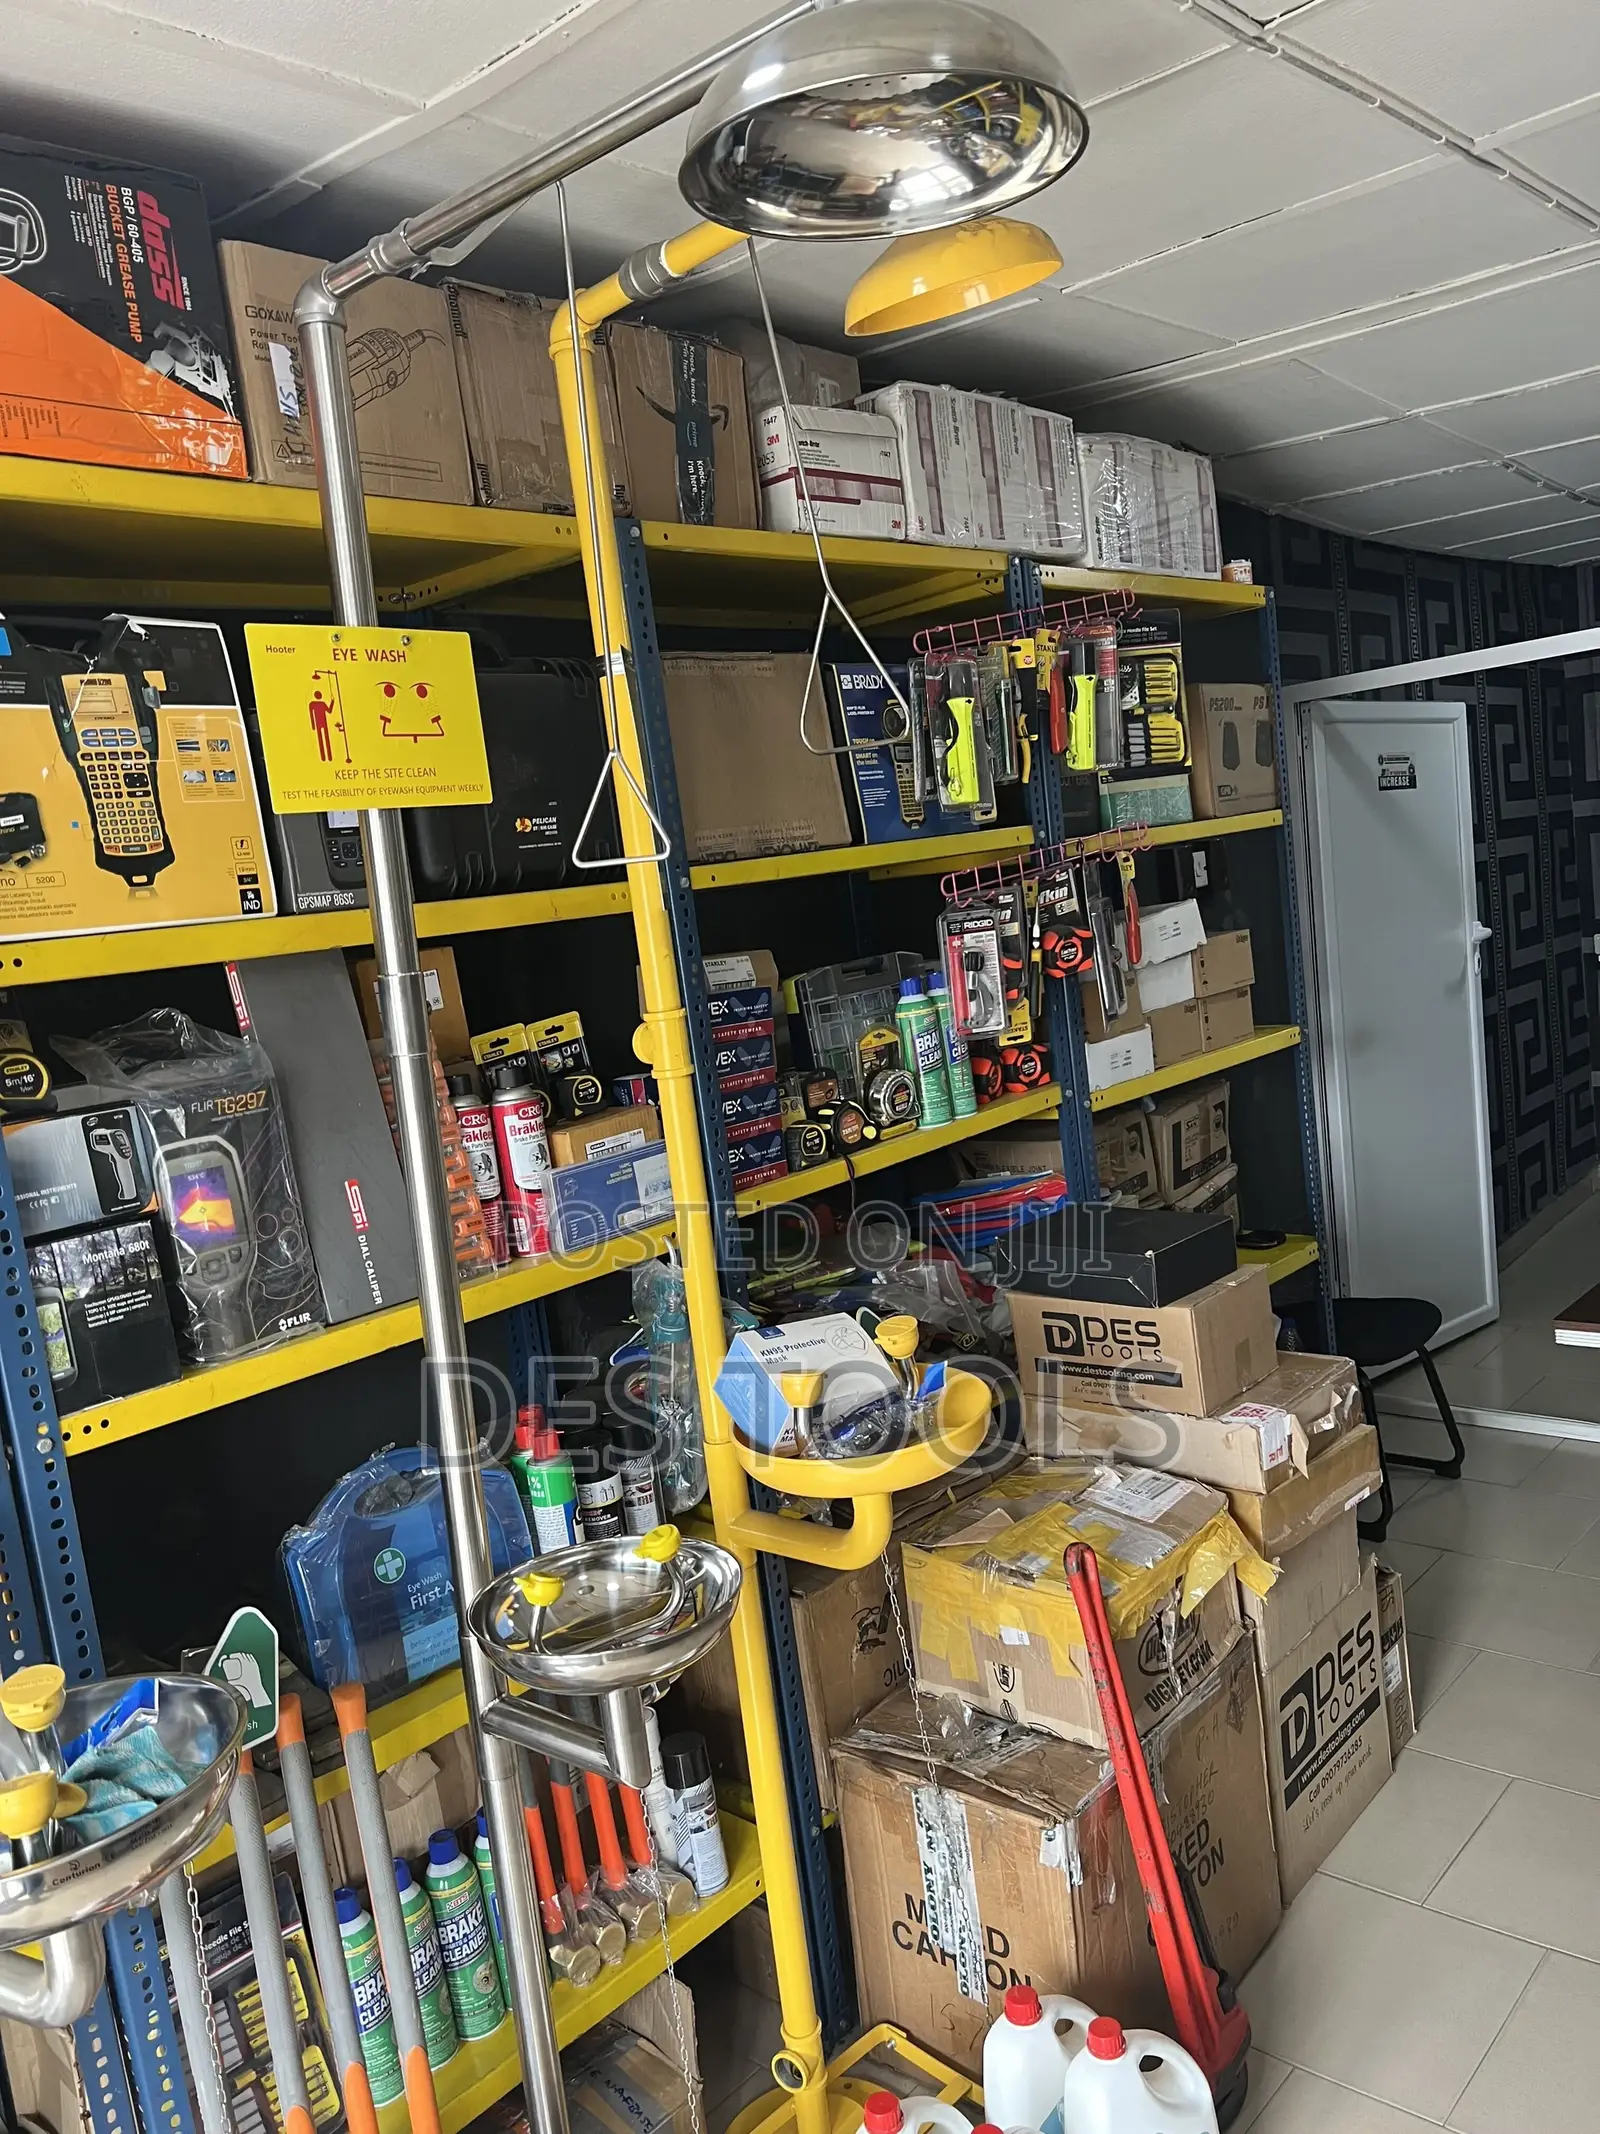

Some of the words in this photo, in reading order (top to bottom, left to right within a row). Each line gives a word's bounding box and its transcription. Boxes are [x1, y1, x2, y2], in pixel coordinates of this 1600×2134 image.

[120, 186, 136, 215] BGP
[128, 224, 144, 264] 60-405
[105, 184, 126, 241] BUCKET
[116, 242, 136, 300] GREASE
[126, 302, 143, 344] PUMP
[250, 328, 279, 340] Power
[763, 416, 778, 427] 7447
[690, 420, 698, 449] prime
[766, 434, 780, 446] 3M
[688, 478, 697, 496] here.
[892, 520, 902, 530] 3M
[265, 644, 297, 655] Hooter
[332, 648, 358, 662] EYE
[364, 648, 408, 664] WASH
[853, 674, 884, 690] BRADY
[334, 768, 360, 781] KEEP
[362, 768, 382, 780] THE
[384, 768, 404, 780] SITE
[406, 767, 437, 778] CLEAN
[1380, 776, 1411, 788] INCREASE
[282, 790, 301, 800] TEST
[302, 790, 320, 799] THE
[320, 788, 365, 798] FEASIBILITY
[366, 787, 378, 796] OF
[378, 786, 414, 796] EYEWASH
[416, 784, 457, 795] EQUIPMENT
[458, 784, 485, 794] WEEKLY
[532, 816, 557, 824] PELICAN
[36, 876, 56, 885] 5200
[243, 900, 261, 912] IND
[298, 896, 332, 910] GPSMAP
[334, 892, 356, 906] 86SC
[964, 918, 994, 930] RIDGID
[704, 960, 727, 968] STANLEY
[718, 1028, 738, 1039] SAFETY
[738, 1026, 763, 1036] EYEWEAR
[6, 1064, 28, 1074] STANLEY
[726, 1078, 744, 1088] SAFETY
[744, 1074, 766, 1084] EYEWEAR
[191, 1100, 214, 1114] FLIR
[214, 1090, 267, 1116] TG297
[462, 1112, 487, 1126] CRC
[518, 1106, 540, 1118] CRC
[732, 1126, 750, 1138] SAFETY
[750, 1122, 772, 1133] EYEWEAR
[735, 1174, 754, 1186] SAFETY
[754, 1168, 777, 1180] EYEWEAR
[82, 1247, 126, 1265] Montana
[128, 1240, 151, 1254] 680t
[358, 1234, 372, 1260] DIAL
[364, 1260, 384, 1306] CALIPER
[287, 1312, 312, 1328] FLIR
[1083, 1316, 1162, 1348] DES
[760, 1346, 784, 1358] KN95
[784, 1337, 827, 1354] Protective
[1086, 1344, 1164, 1364] TOOLS
[765, 1354, 789, 1366] Mask
[1059, 1364, 1156, 1382] www.destoolsng.com
[408, 1584, 421, 1594] Eye
[421, 1572, 443, 1586] Wash
[410, 1586, 441, 1610] First
[1316, 1610, 1376, 1711] DES
[1318, 1657, 1378, 1738] TOOLS
[1300, 1708, 1367, 1784] www.destoolsng.com
[1308, 1785, 1320, 1803] Call
[1321, 1734, 1364, 1790] 09079736285
[52, 1862, 101, 1886] Centurion
[228, 1924, 243, 1938] File
[438, 1903, 484, 1945] BRAKE
[443, 1927, 488, 1964] CLEANER
[445, 1940, 463, 1950] PARTS
